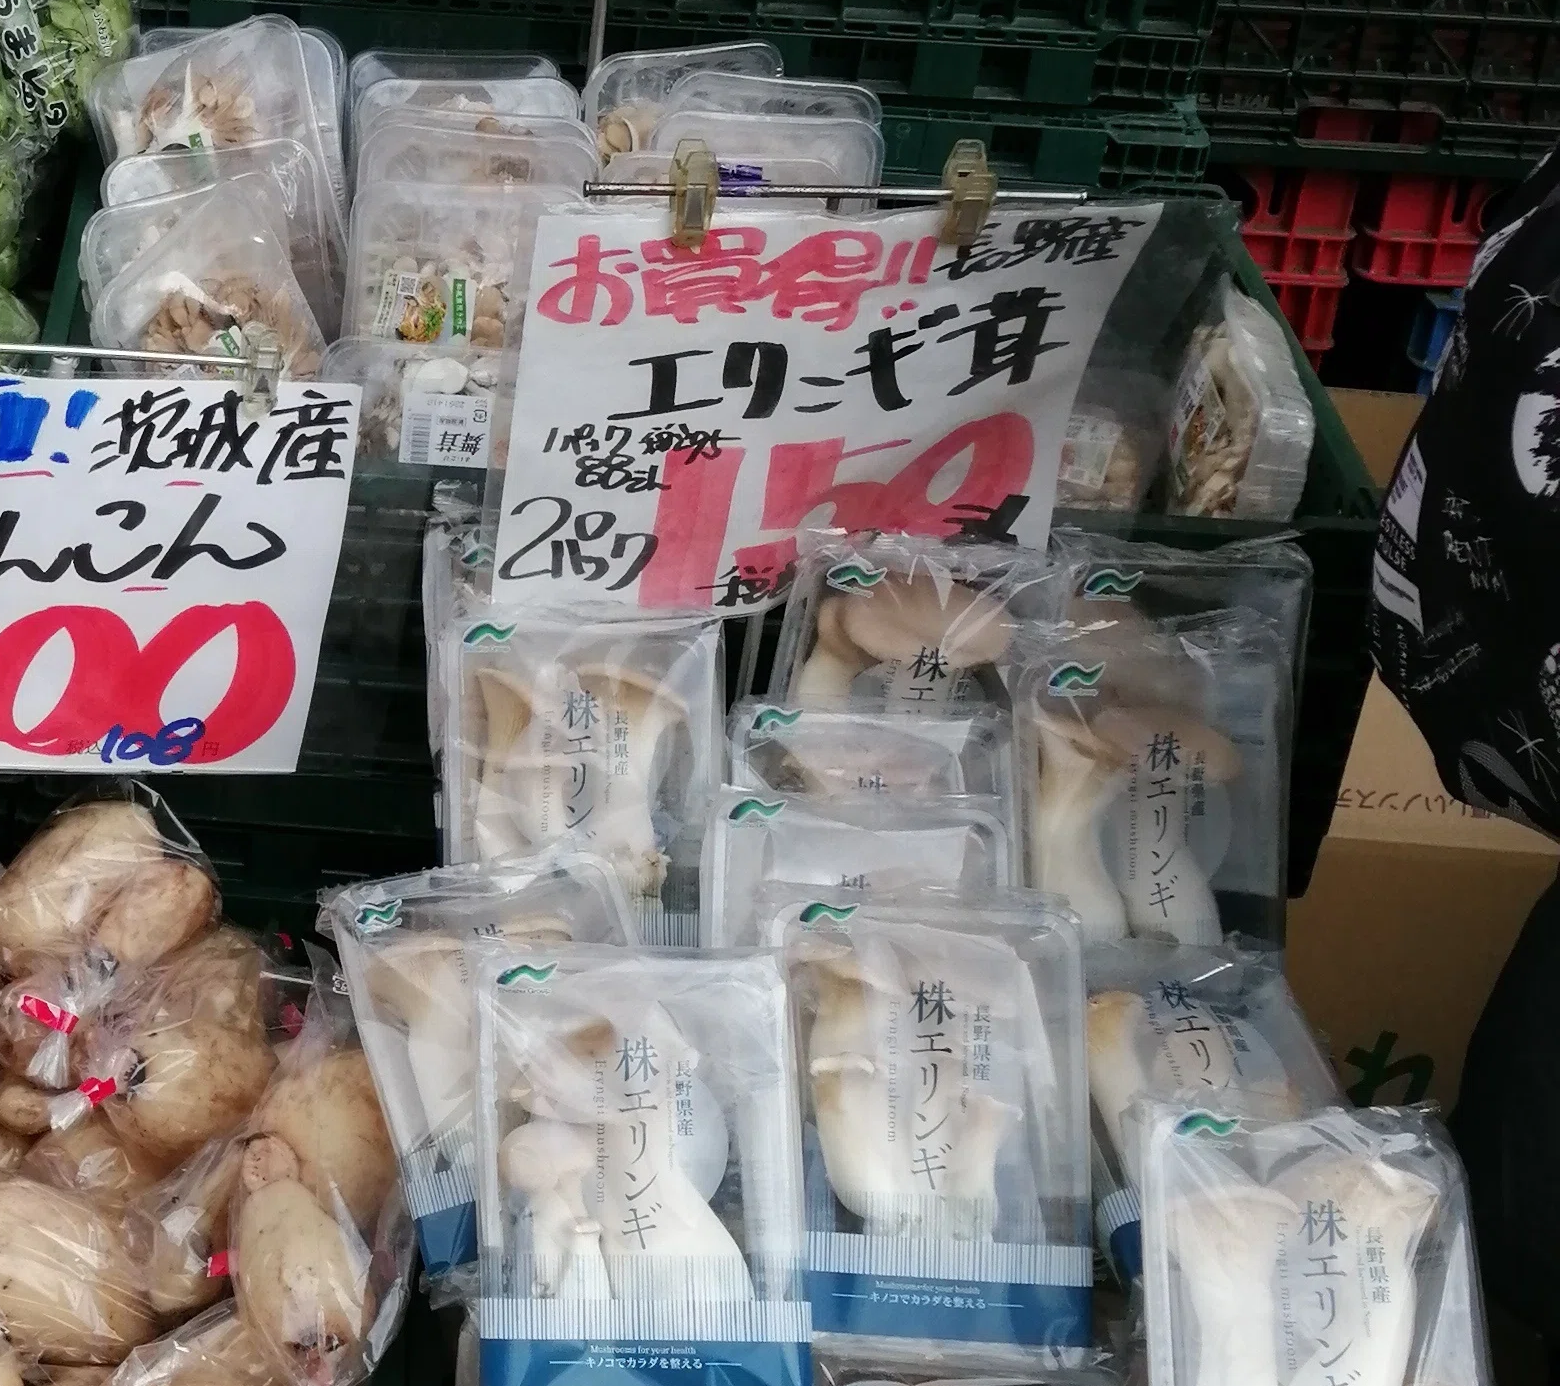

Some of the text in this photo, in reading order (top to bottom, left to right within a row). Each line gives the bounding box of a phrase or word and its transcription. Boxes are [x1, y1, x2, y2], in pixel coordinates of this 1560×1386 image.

[637, 412, 1035, 609] 150
[100, 717, 208, 766] 108
[1144, 730, 1183, 919] 株エリンギ
[972, 1003, 992, 1082] 長野県産
[674, 1059, 696, 1139] 長野県産
[908, 978, 956, 1191] 株エリンギ
[614, 1035, 663, 1252] 株エリンギ
[869, 1290, 988, 1311] キノコでカラダを整える
[1365, 1226, 1392, 1306] 長野県産
[584, 1355, 704, 1370] キノコでカラダを整える
